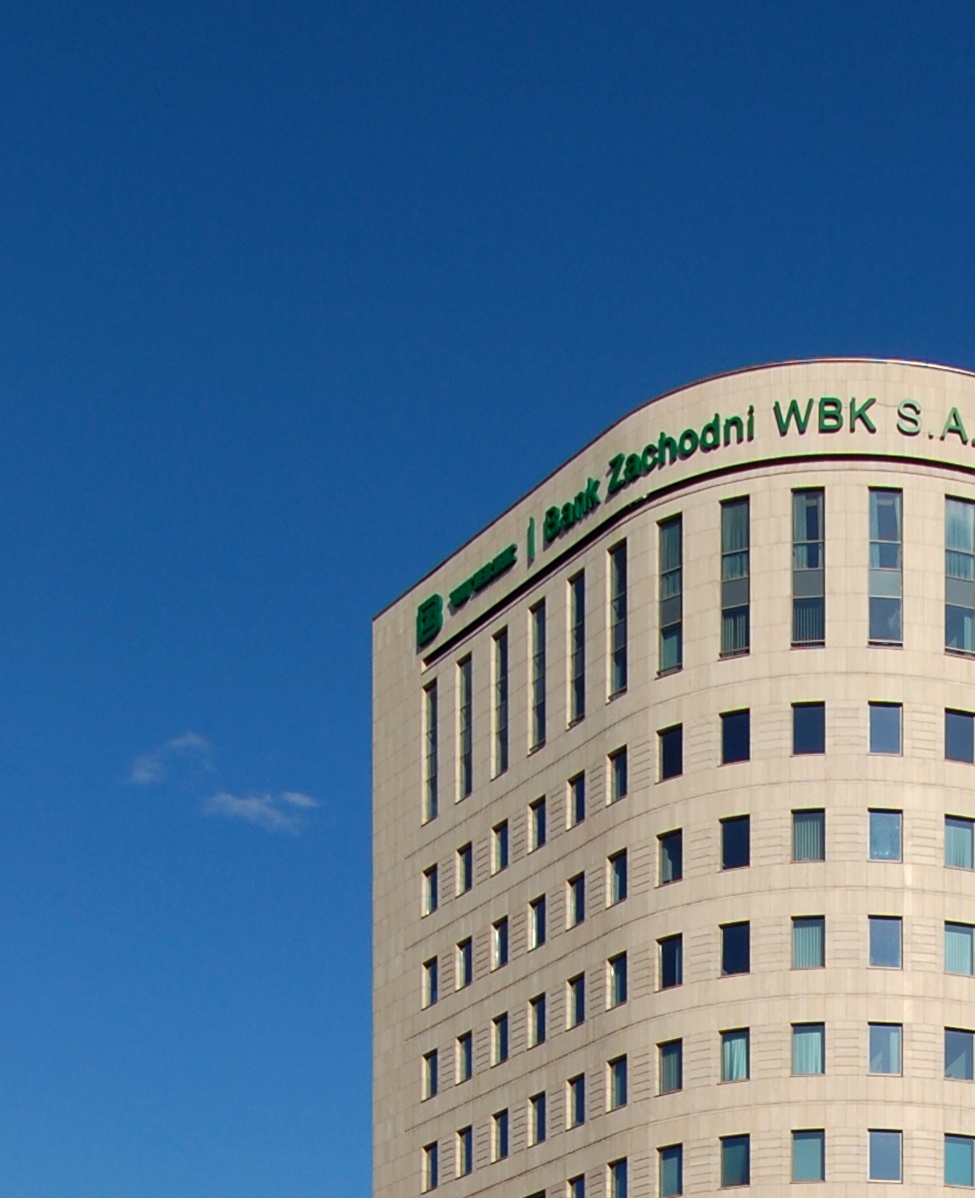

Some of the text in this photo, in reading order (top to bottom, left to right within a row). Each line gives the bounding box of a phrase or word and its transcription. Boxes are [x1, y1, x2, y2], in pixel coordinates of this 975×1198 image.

[544, 477, 600, 543] Bank
[607, 404, 754, 496] Zachodni
[773, 396, 877, 437] WBK
